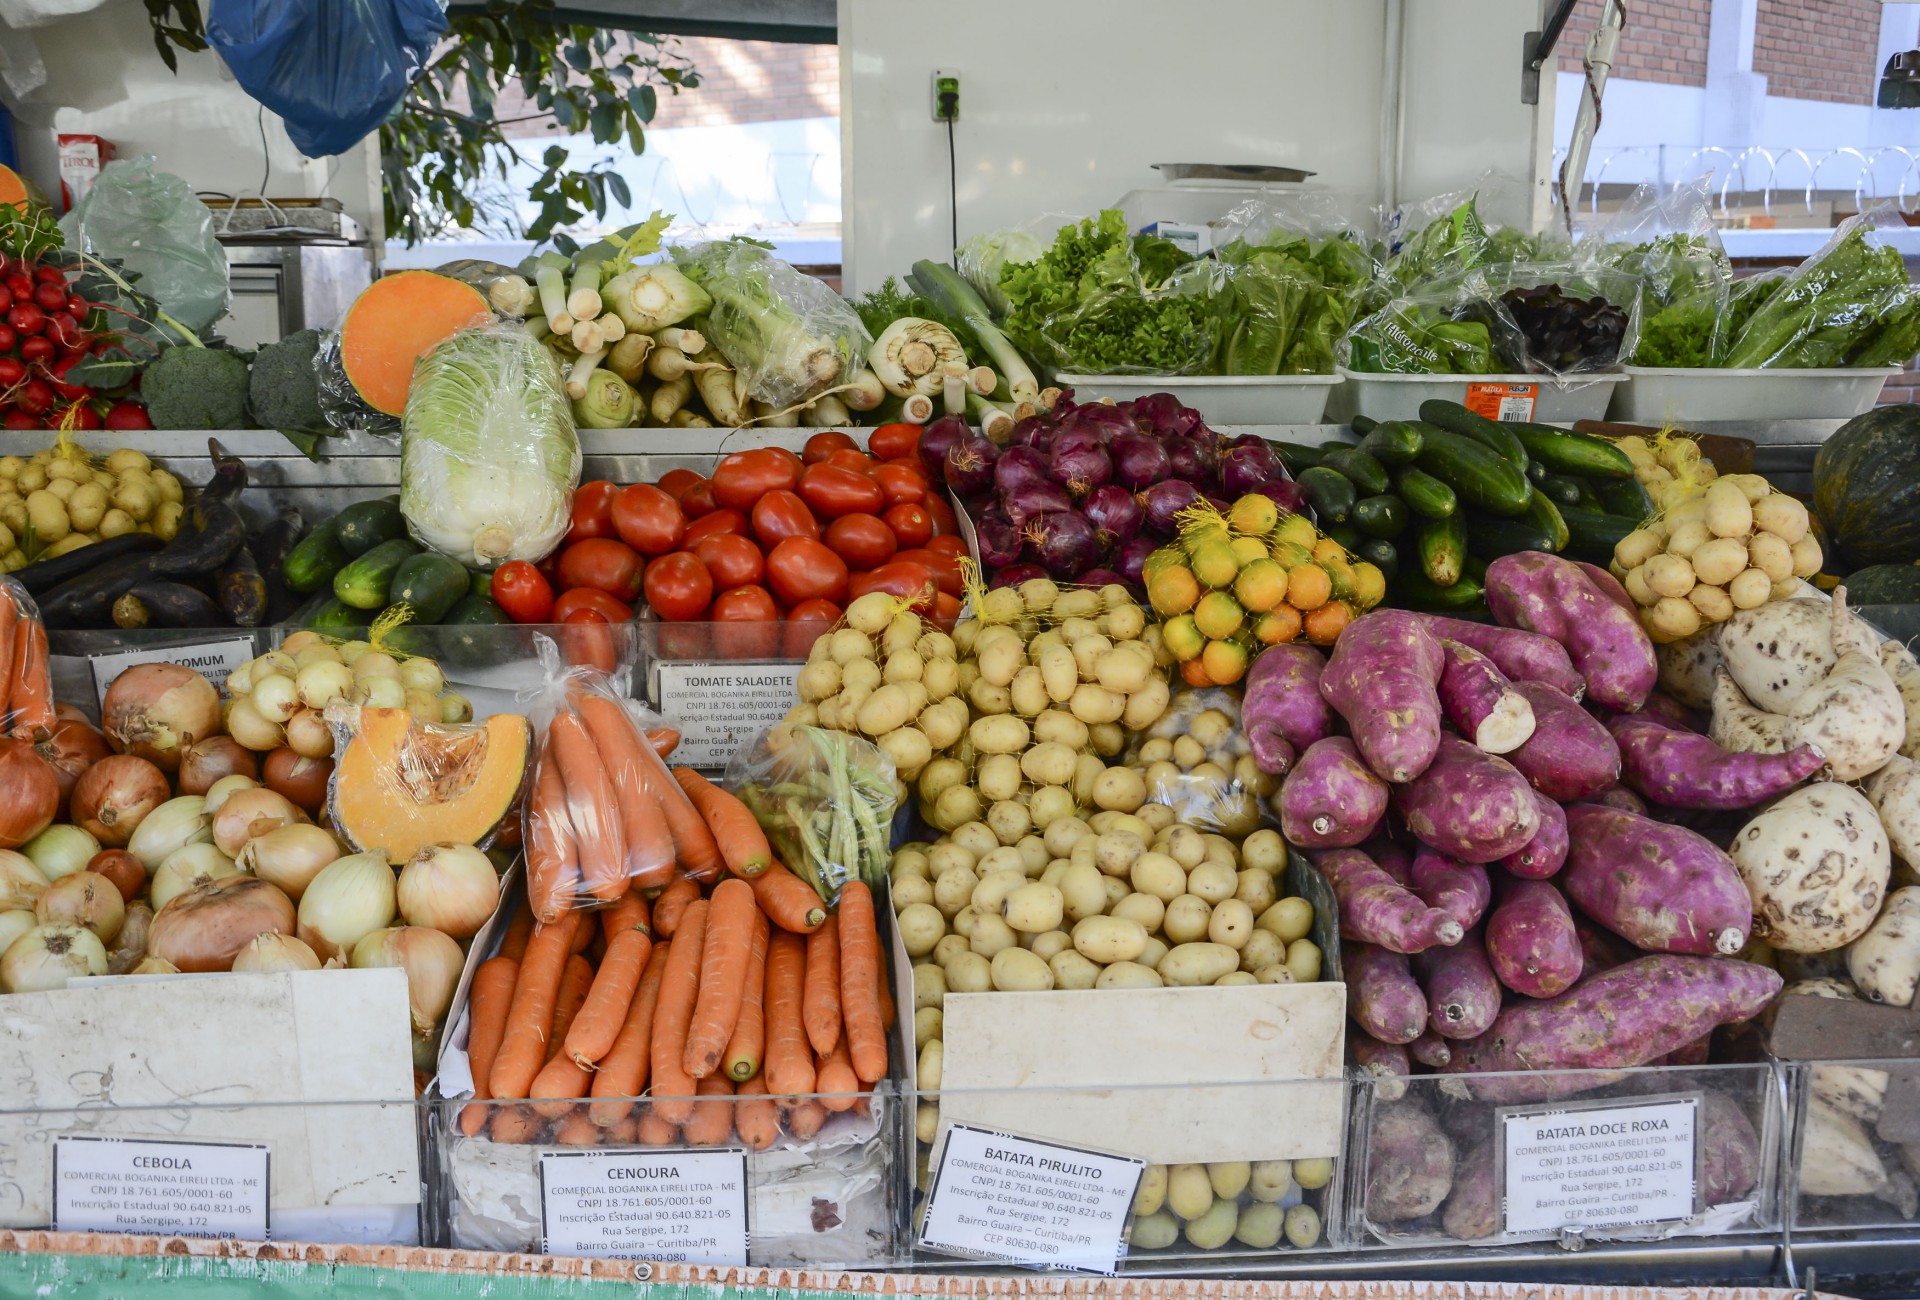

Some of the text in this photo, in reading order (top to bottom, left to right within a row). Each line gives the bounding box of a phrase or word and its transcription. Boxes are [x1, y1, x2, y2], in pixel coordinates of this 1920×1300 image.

[684, 676, 792, 687] TOMATE SALADETE
[666, 691, 709, 699] COMERCIAL
[711, 691, 750, 699] BOGANIKA
[774, 690, 792, 698] LTDA
[686, 701, 792, 710] CNPJ 18.761.605/0001-60
[680, 713, 710, 723] scrição
[710, 713, 745, 721] Estadual
[705, 725, 721, 733] Rua
[709, 748, 725, 757] CEP
[1536, 1119, 1669, 1140] BATATA DOCE ROXA
[1515, 1143, 1567, 1156] COMERCIAL
[1569, 1140, 1616, 1151] BOGANIKA
[1618, 1137, 1644, 1148] EIRELI
[1646, 1135, 1667, 1144] LTDA
[1674, 1133, 1689, 1142] ME
[132, 1156, 192, 1170] CEBOLA
[984, 1147, 1102, 1179] BATATA PIRULITO
[1539, 1148, 1666, 1168] CNPJ 18.761.605/0001-60
[64, 1171, 122, 1181] COMERCIAL
[125, 1173, 177, 1183] BOGANIKA
[179, 1175, 208, 1185] EIRELI
[210, 1176, 234, 1186] LTDA
[243, 1178, 258, 1187] ME
[607, 1167, 680, 1180] CENOURA
[951, 1158, 1003, 1175] COMERCIAL
[1005, 1169, 1052, 1184] BOGANIKA
[1054, 1177, 1081, 1190] EIRELI
[1083, 1183, 1104, 1193] LTDA
[1111, 1187, 1127, 1197] ME
[1521, 1160, 1682, 1183] Inscrição Estadual 90.640.821-05
[91, 1185, 233, 1199] CNPJ 18.761.605/0001-60
[551, 1186, 606, 1195] COMERCIAL
[608, 1184, 658, 1194] BOGANIKA
[660, 1184, 688, 1193] EIRELI
[690, 1183, 713, 1192] LTDA
[721, 1182, 736, 1191] ME
[971, 1175, 1100, 1205] CNPJ 18.761.605/0001-60
[1561, 1177, 1643, 1193] Rua Sergipe, 172
[71, 1199, 252, 1214] Inscrição Estadual 90.640.821-05
[577, 1196, 712, 1208] CNPJ 18.761.605/0001-60
[950, 1185, 1112, 1220] Inscrição Estadual 90.640.821-05
[1535, 1199, 1565, 1209] Bairro
[1611, 1189, 1668, 1202] Curitiba/PR
[559, 1209, 731, 1224] Inscrição Estadual 90.640.821-05
[986, 1205, 1069, 1227] Rua Sergipe, 172
[1564, 1205, 1639, 1220] CEP 80630-080
[116, 1214, 208, 1227] Rua Sergipe, 172
[602, 1224, 689, 1236] Rua Sergipe, 172
[957, 1214, 988, 1227] Bairro
[1034, 1227, 1091, 1246] Curitiba/PR
[1519, 1228, 1550, 1236] PRODUTO
[1595, 1221, 1632, 1230] RASTREADA
[576, 1241, 607, 1250] Bairro
[657, 1237, 717, 1248] Curitiba/PR
[984, 1232, 1059, 1255] CEP 80630-080
[631, 1253, 687, 1262] 80630-080
[936, 1242, 1013, 1261] PRODUTO COM ORIGEM
